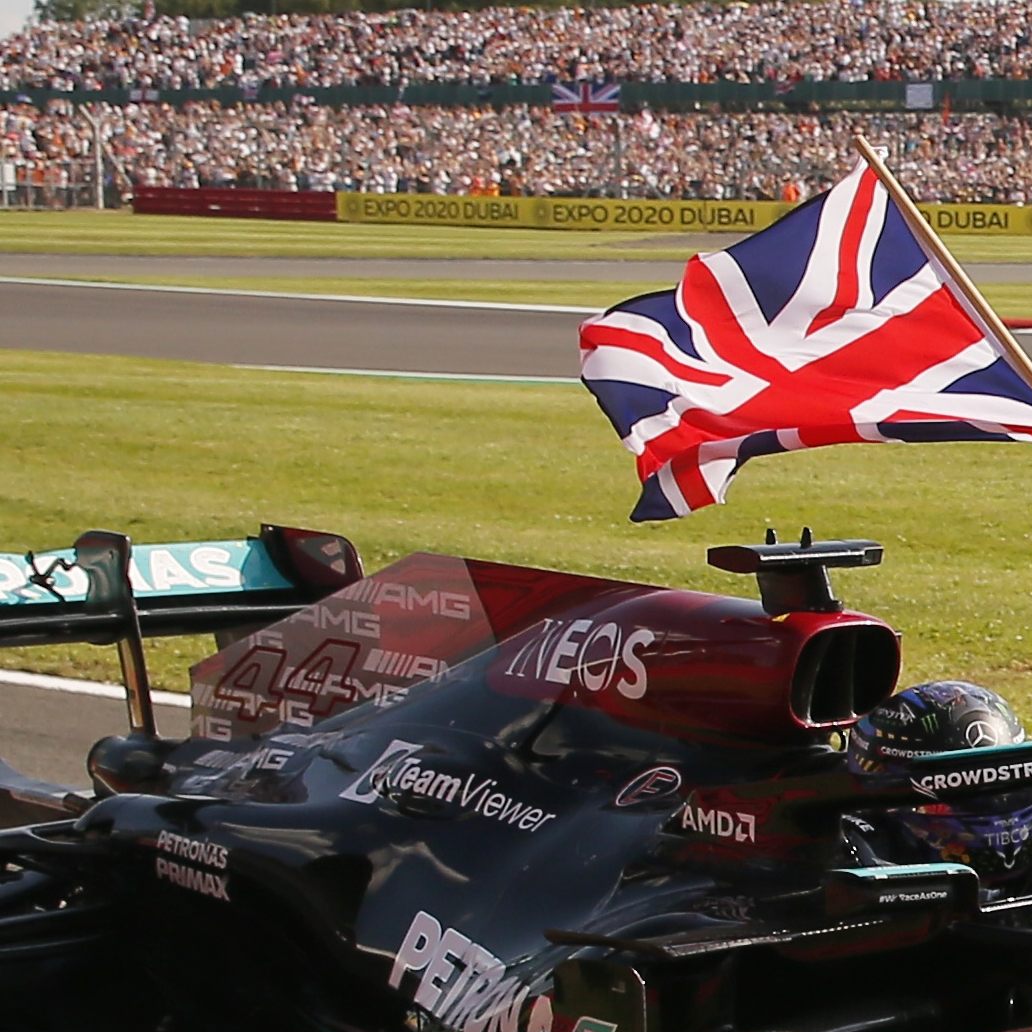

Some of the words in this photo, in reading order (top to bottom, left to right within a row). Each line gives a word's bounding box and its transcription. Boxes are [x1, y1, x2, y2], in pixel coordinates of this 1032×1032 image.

[365, 200, 409, 217] EXPO
[414, 201, 458, 218] 2020
[463, 202, 518, 220] DUBAI
[553, 204, 608, 223] EXPO
[614, 206, 674, 225] 2020
[680, 207, 754, 225] DUBAI
[937, 211, 1008, 229] DUBAI
[214, 638, 361, 723] 44
[392, 758, 556, 832] TeamViewer
[682, 805, 734, 837] AMD
[156, 829, 229, 869] PETRONAS
[156, 857, 231, 901] PRIMAX
